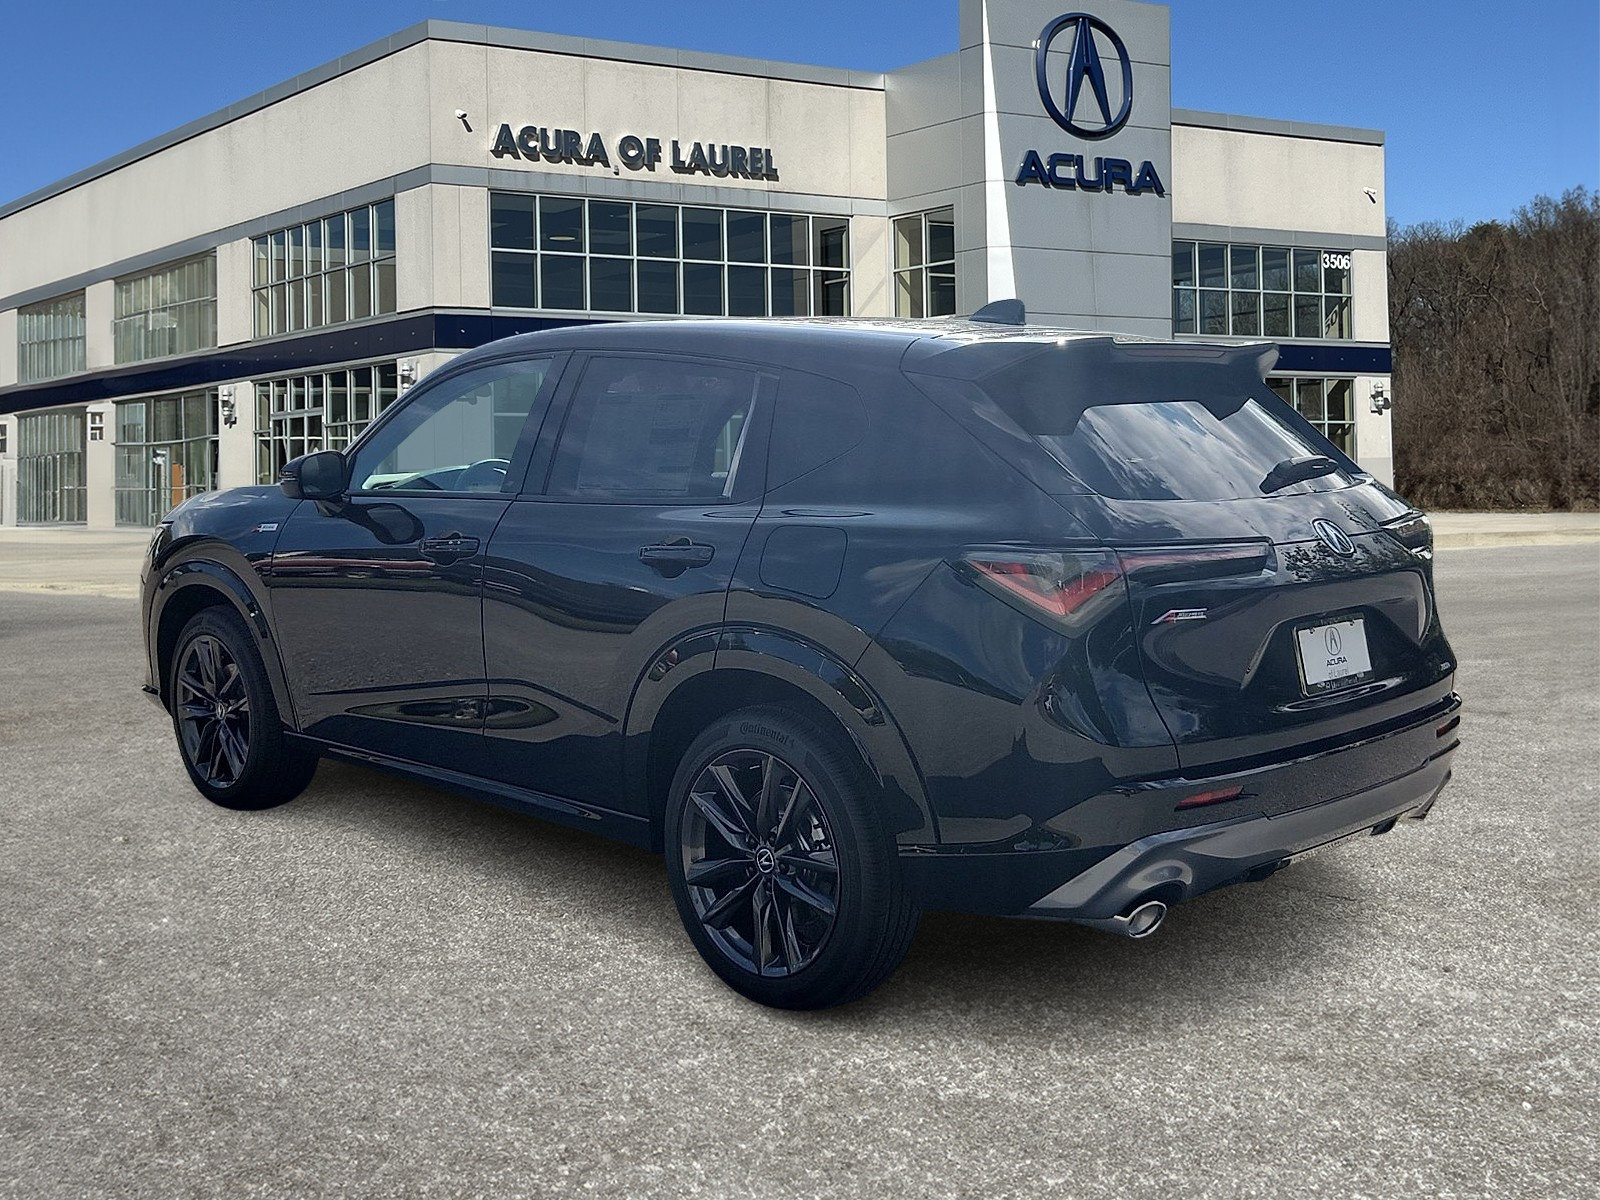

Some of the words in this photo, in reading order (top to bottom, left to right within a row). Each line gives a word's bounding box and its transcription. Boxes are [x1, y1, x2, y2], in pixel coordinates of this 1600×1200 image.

[491, 123, 611, 167] ACURA
[618, 135, 662, 171] OF
[671, 139, 779, 181] LAUREL
[1015, 149, 1165, 197] ACURA
[1322, 253, 1351, 270] 3506
[1326, 656, 1348, 667] ACURA
[739, 721, 789, 745] Continental
